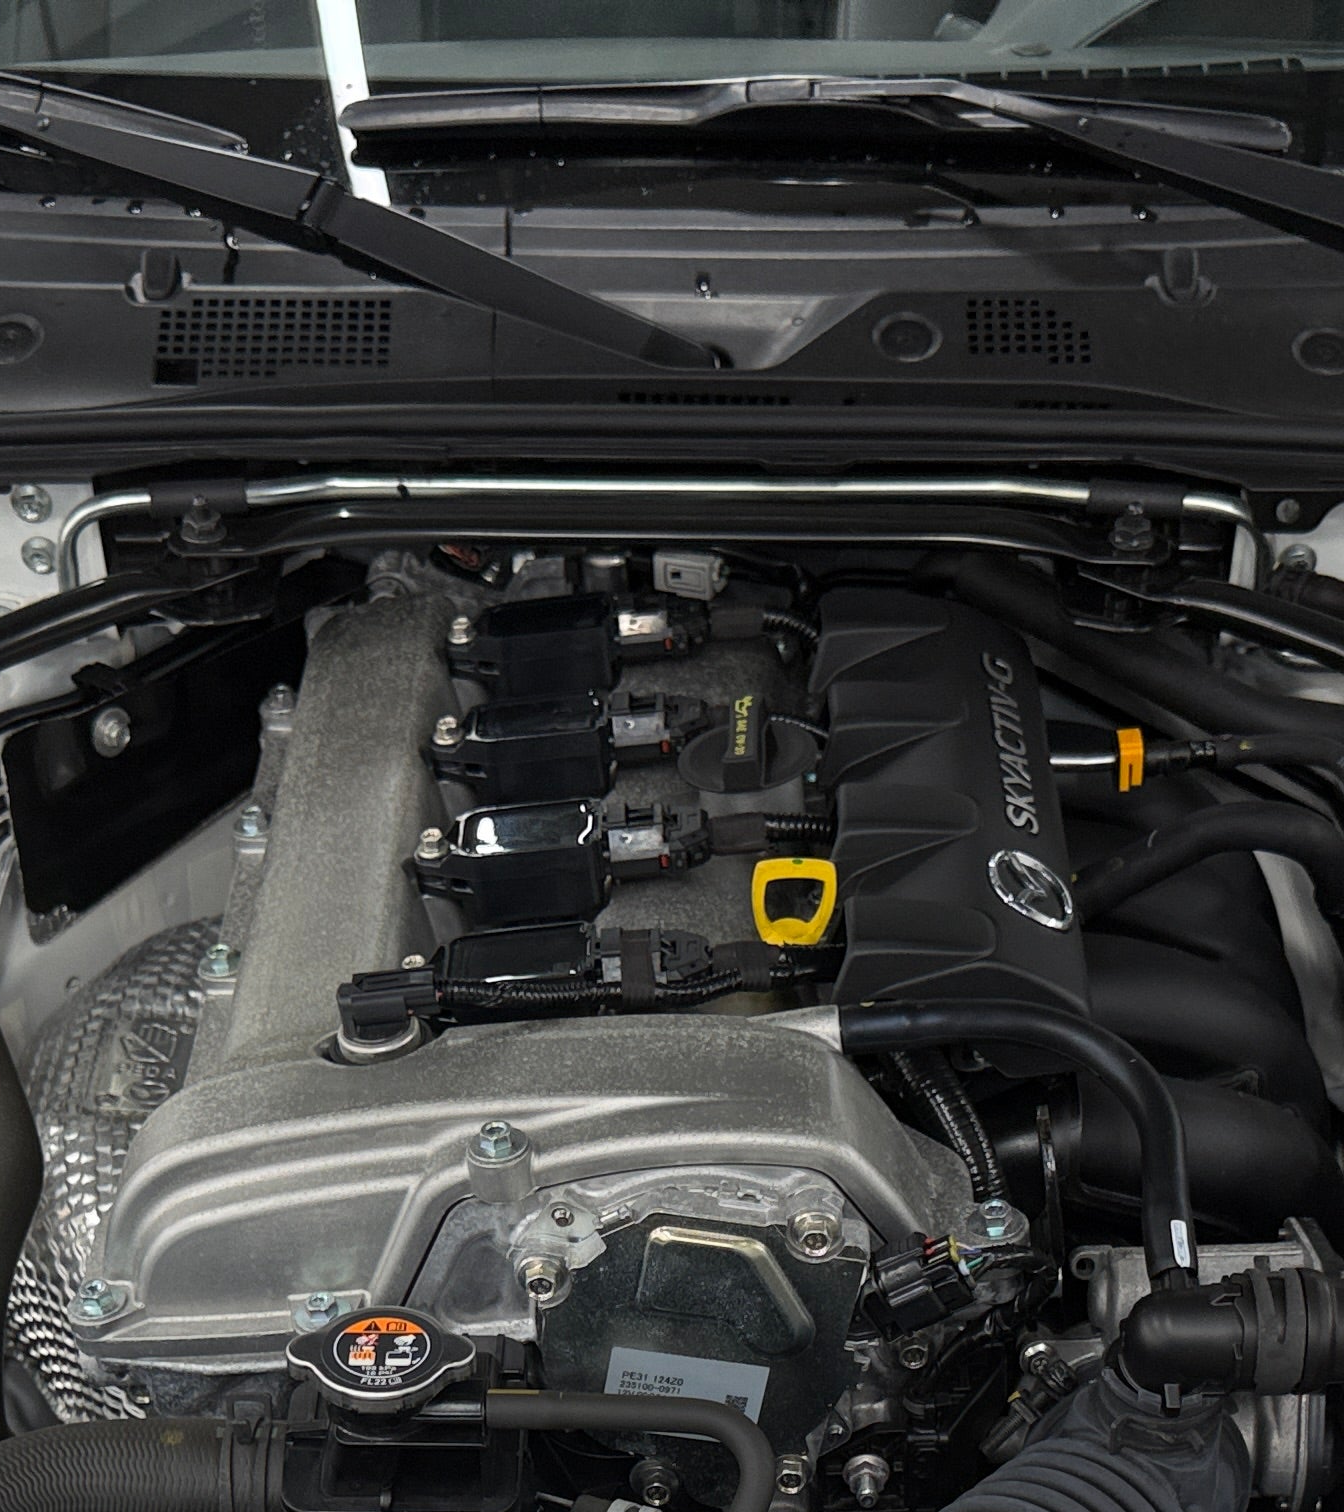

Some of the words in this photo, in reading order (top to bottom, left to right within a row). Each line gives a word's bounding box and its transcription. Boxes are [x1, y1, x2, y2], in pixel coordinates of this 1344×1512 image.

[982, 652, 1039, 834] SKYACTIV-G
[360, 1377, 386, 1385] FL22
[621, 1370, 647, 1381] PE31
